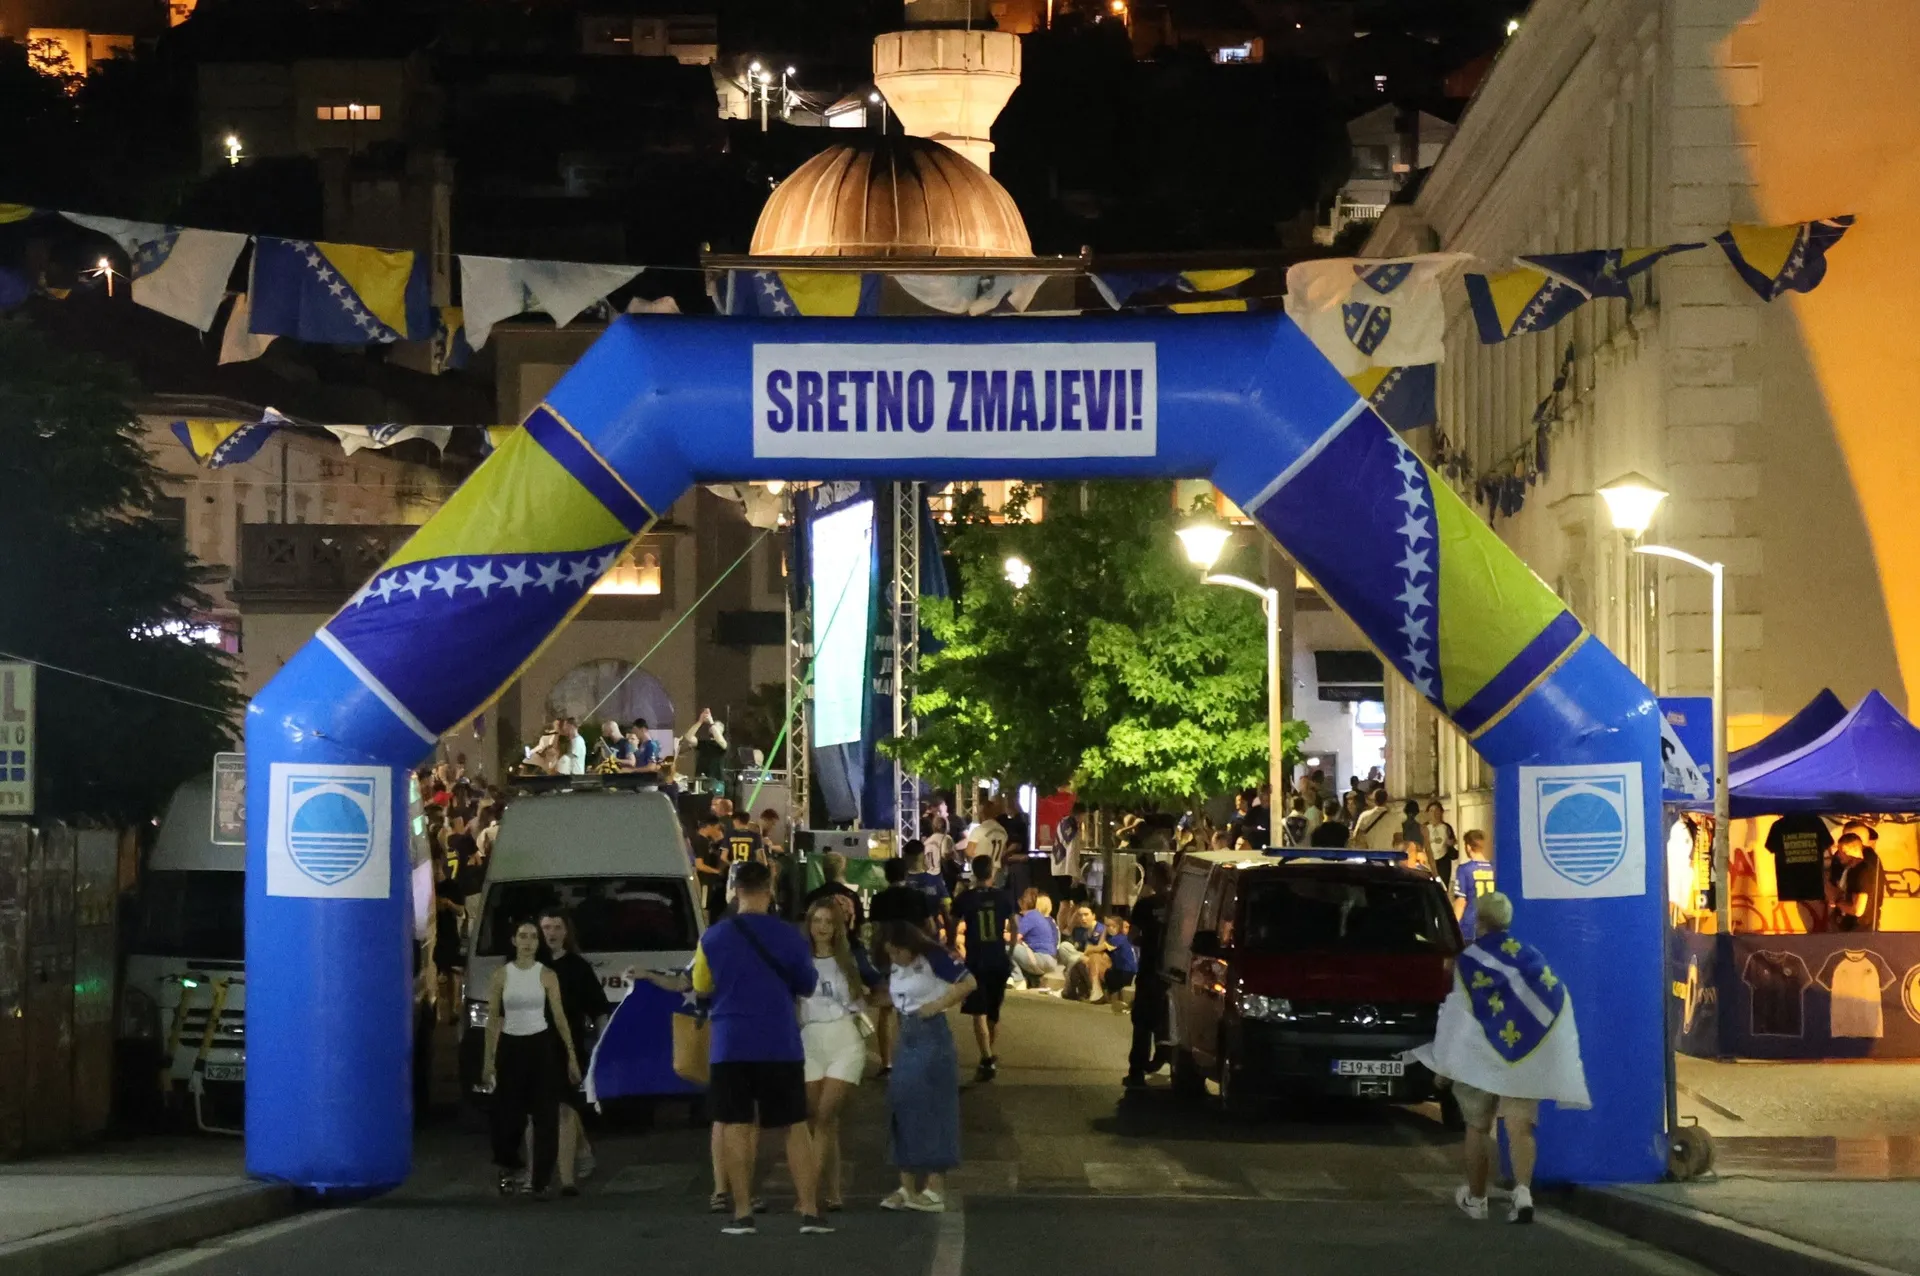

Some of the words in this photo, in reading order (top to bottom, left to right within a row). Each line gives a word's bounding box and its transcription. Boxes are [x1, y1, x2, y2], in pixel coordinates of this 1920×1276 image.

[766, 369, 935, 433] SRETNO
[946, 369, 1143, 432] ZMAJEVI!
[731, 843, 750, 862] 19
[447, 859, 459, 880] 7
